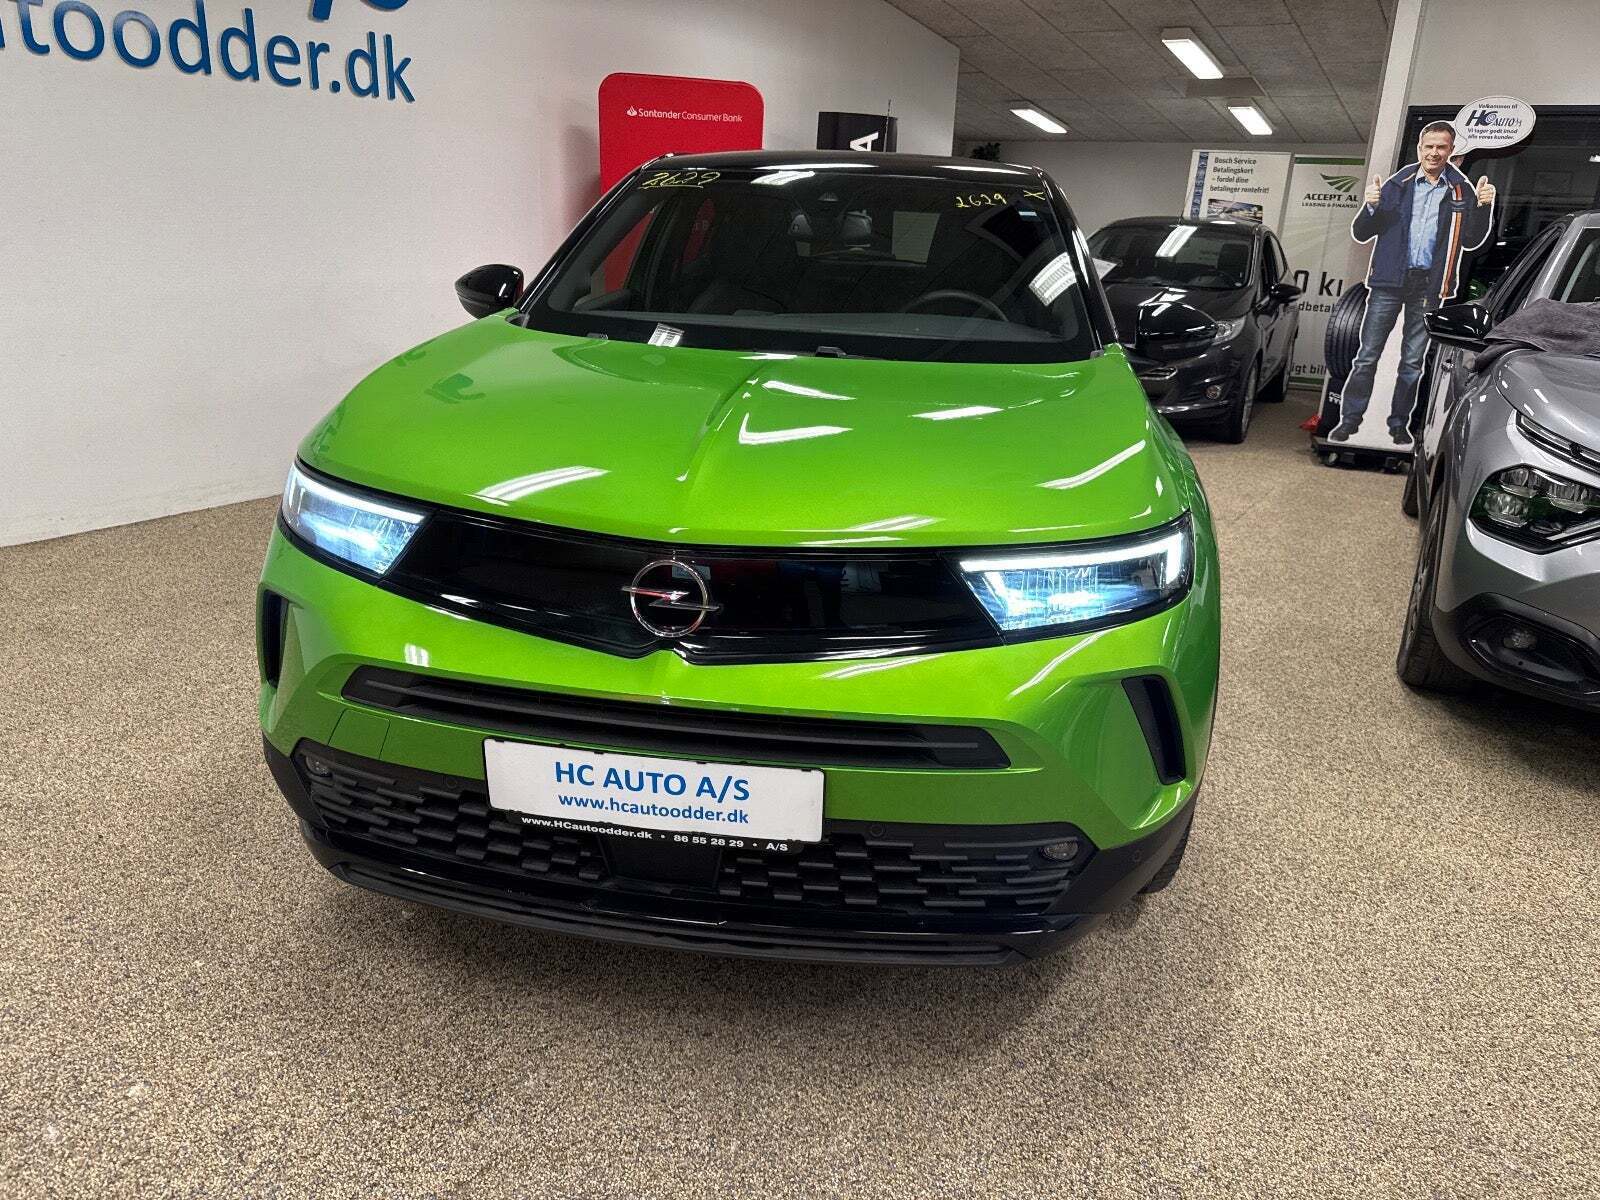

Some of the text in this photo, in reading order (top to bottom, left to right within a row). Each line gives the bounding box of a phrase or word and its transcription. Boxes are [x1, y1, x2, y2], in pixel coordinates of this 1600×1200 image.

[0, 0, 416, 103] toodder.dk
[639, 108, 742, 122] Santander Consumer Bank
[555, 761, 750, 804] HC AUTO A/S
[558, 794, 749, 824] www.hcautoodder.dk
[521, 816, 788, 851] www.HCautoodder.dk 86 55 28 29 A/S
